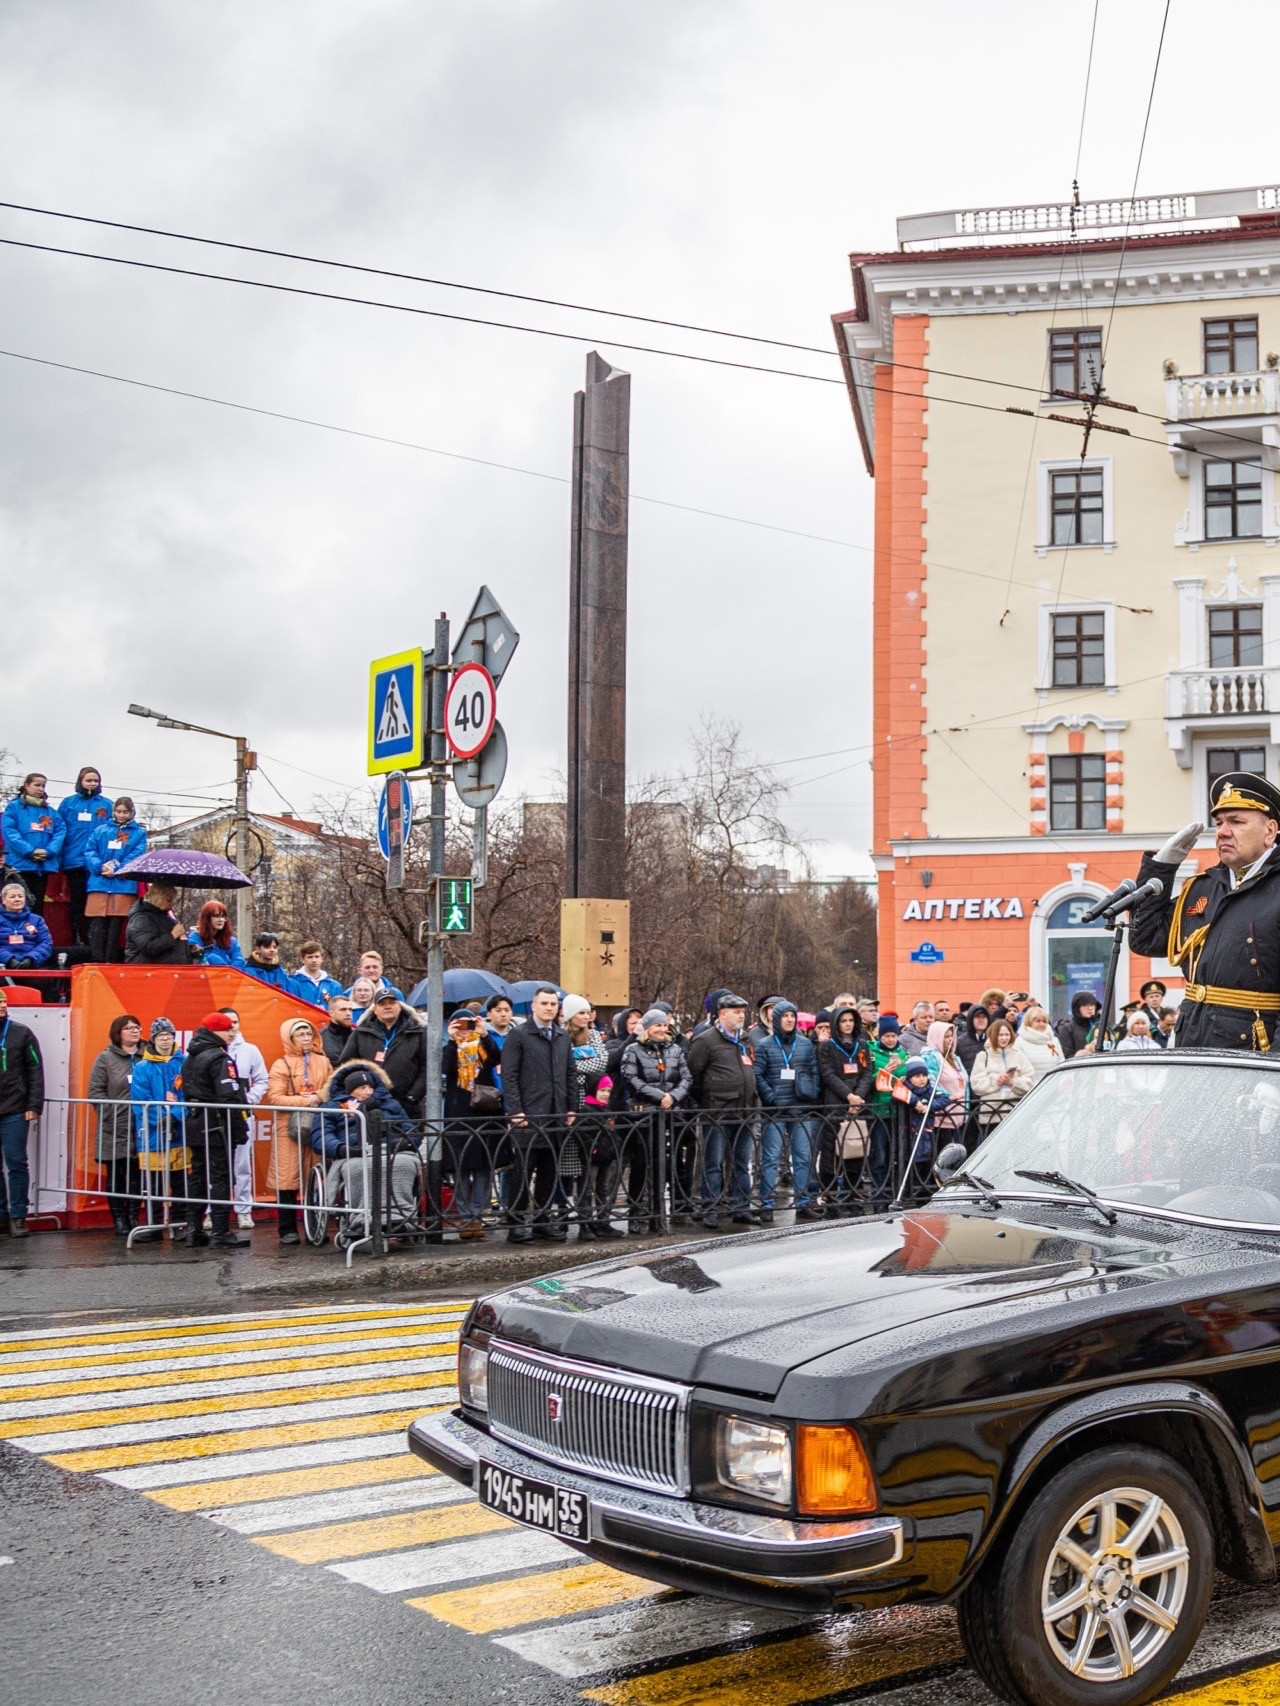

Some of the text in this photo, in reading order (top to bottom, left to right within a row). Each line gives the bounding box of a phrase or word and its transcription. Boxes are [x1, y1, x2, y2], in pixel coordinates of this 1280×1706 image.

[455, 691, 484, 731] 40
[903, 897, 1024, 921] АПТЕКА
[484, 1467, 583, 1528] 1945 НМ 35
[560, 1521, 580, 1536] RUS
